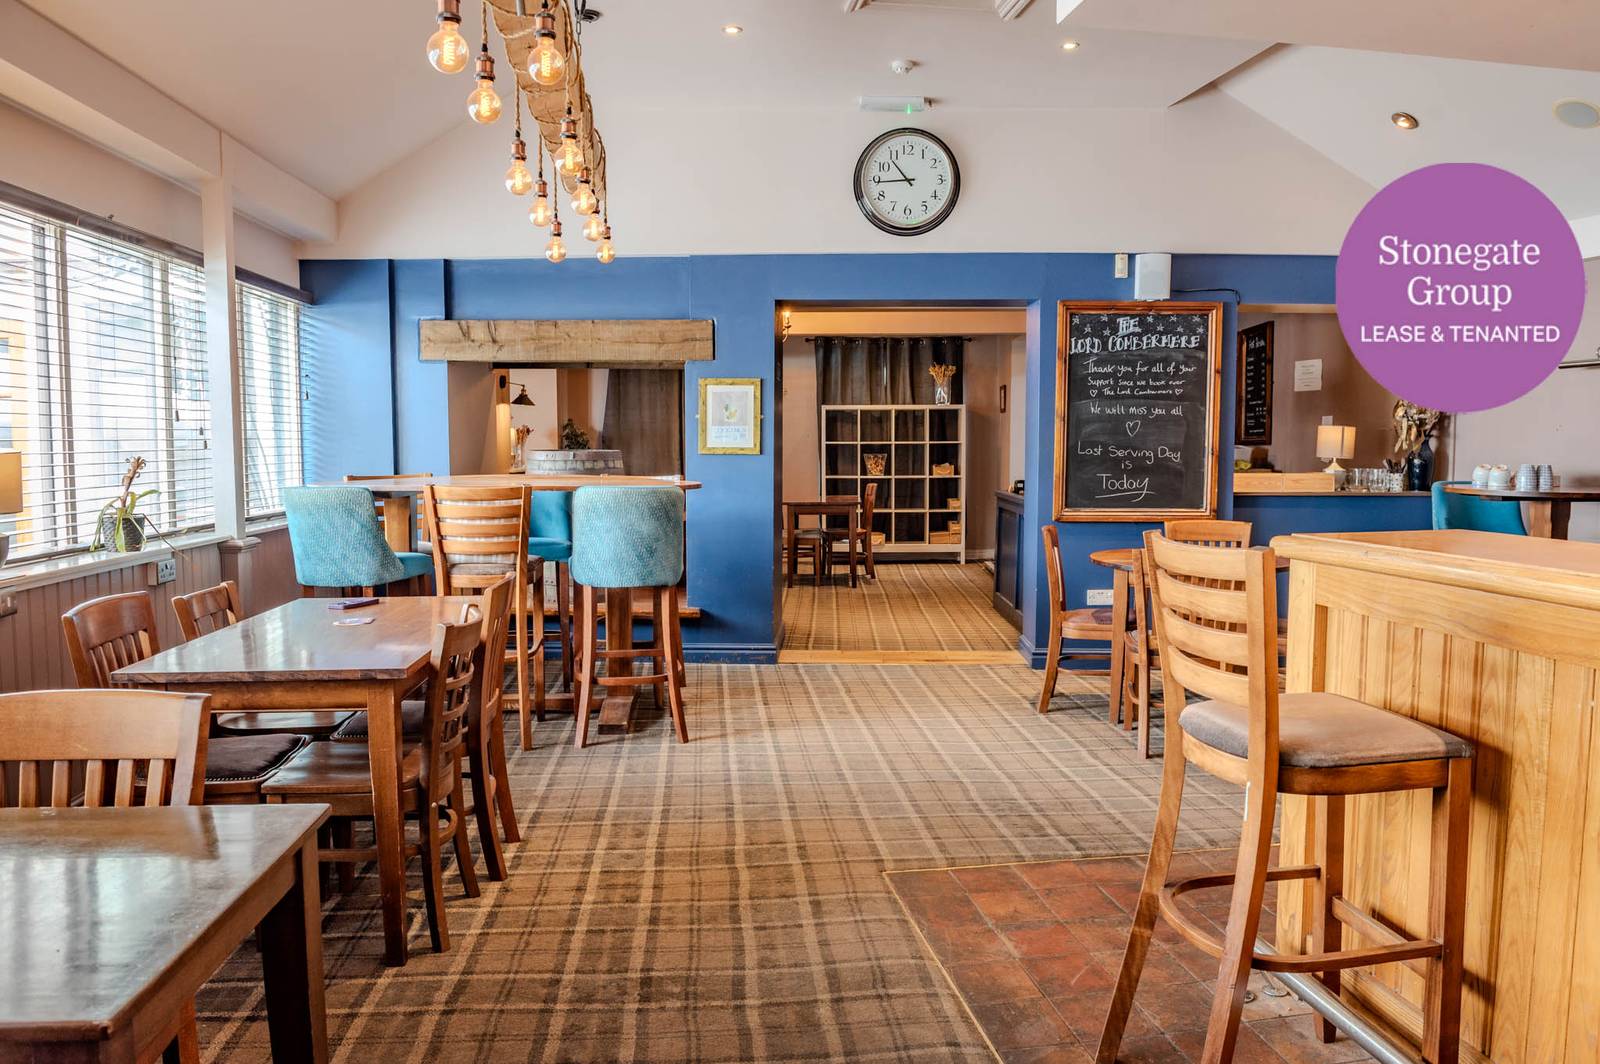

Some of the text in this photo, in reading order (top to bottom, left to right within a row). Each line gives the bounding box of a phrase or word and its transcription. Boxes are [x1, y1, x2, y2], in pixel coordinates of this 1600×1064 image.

[889, 149, 899, 160] 11
[902, 144, 915, 156] 12
[878, 161, 891, 172] 10
[930, 158, 938, 169] 2
[872, 175, 881, 185] 9
[937, 175, 944, 185] 3
[877, 190, 886, 201] 8
[930, 189, 939, 200] 4
[890, 200, 897, 212] 7
[903, 204, 912, 217] 6
[921, 200, 928, 212] 5
[1117, 316, 1141, 335] THE
[1070, 336, 1102, 354] LORD
[1083, 357, 1116, 373] Thank
[1117, 364, 1133, 376] you
[1136, 361, 1150, 375] for
[1151, 362, 1164, 373] all
[1166, 361, 1176, 375] of
[1102, 386, 1115, 396] The
[1089, 402, 1101, 415] We
[1106, 403, 1126, 415] will
[1148, 407, 1166, 418] you
[1170, 405, 1183, 416] all
[1077, 440, 1181, 465] Last Serving Day
[1121, 460, 1133, 470] is
[1096, 473, 1149, 502] Today
